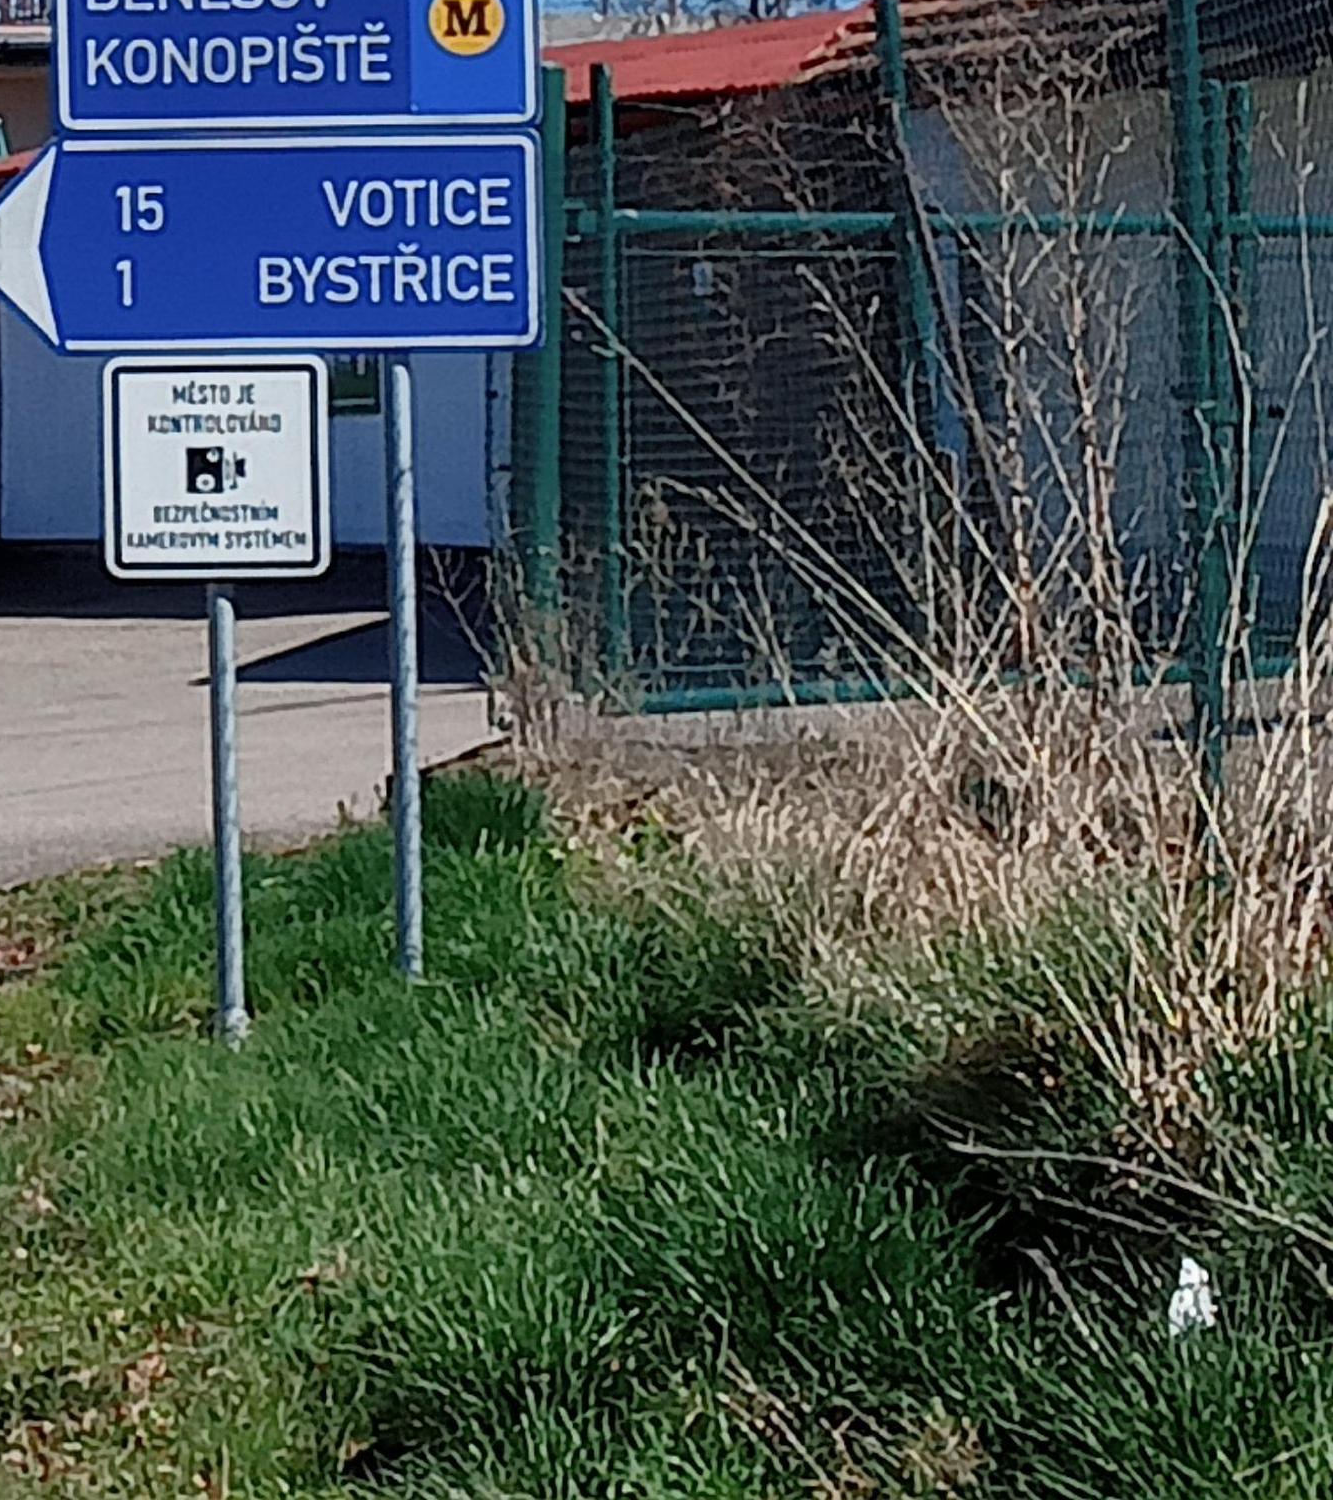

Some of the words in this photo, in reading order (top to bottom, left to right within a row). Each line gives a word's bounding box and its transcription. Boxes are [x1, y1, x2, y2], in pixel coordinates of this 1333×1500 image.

[86, 23, 392, 86] KONOPIŠTĚ
[115, 186, 165, 232] 15
[322, 177, 512, 228] VOTICE
[115, 261, 133, 306] 1
[259, 245, 515, 304] BYSTŘICE
[172, 381, 230, 405] MĚSTO
[237, 383, 255, 404] JE
